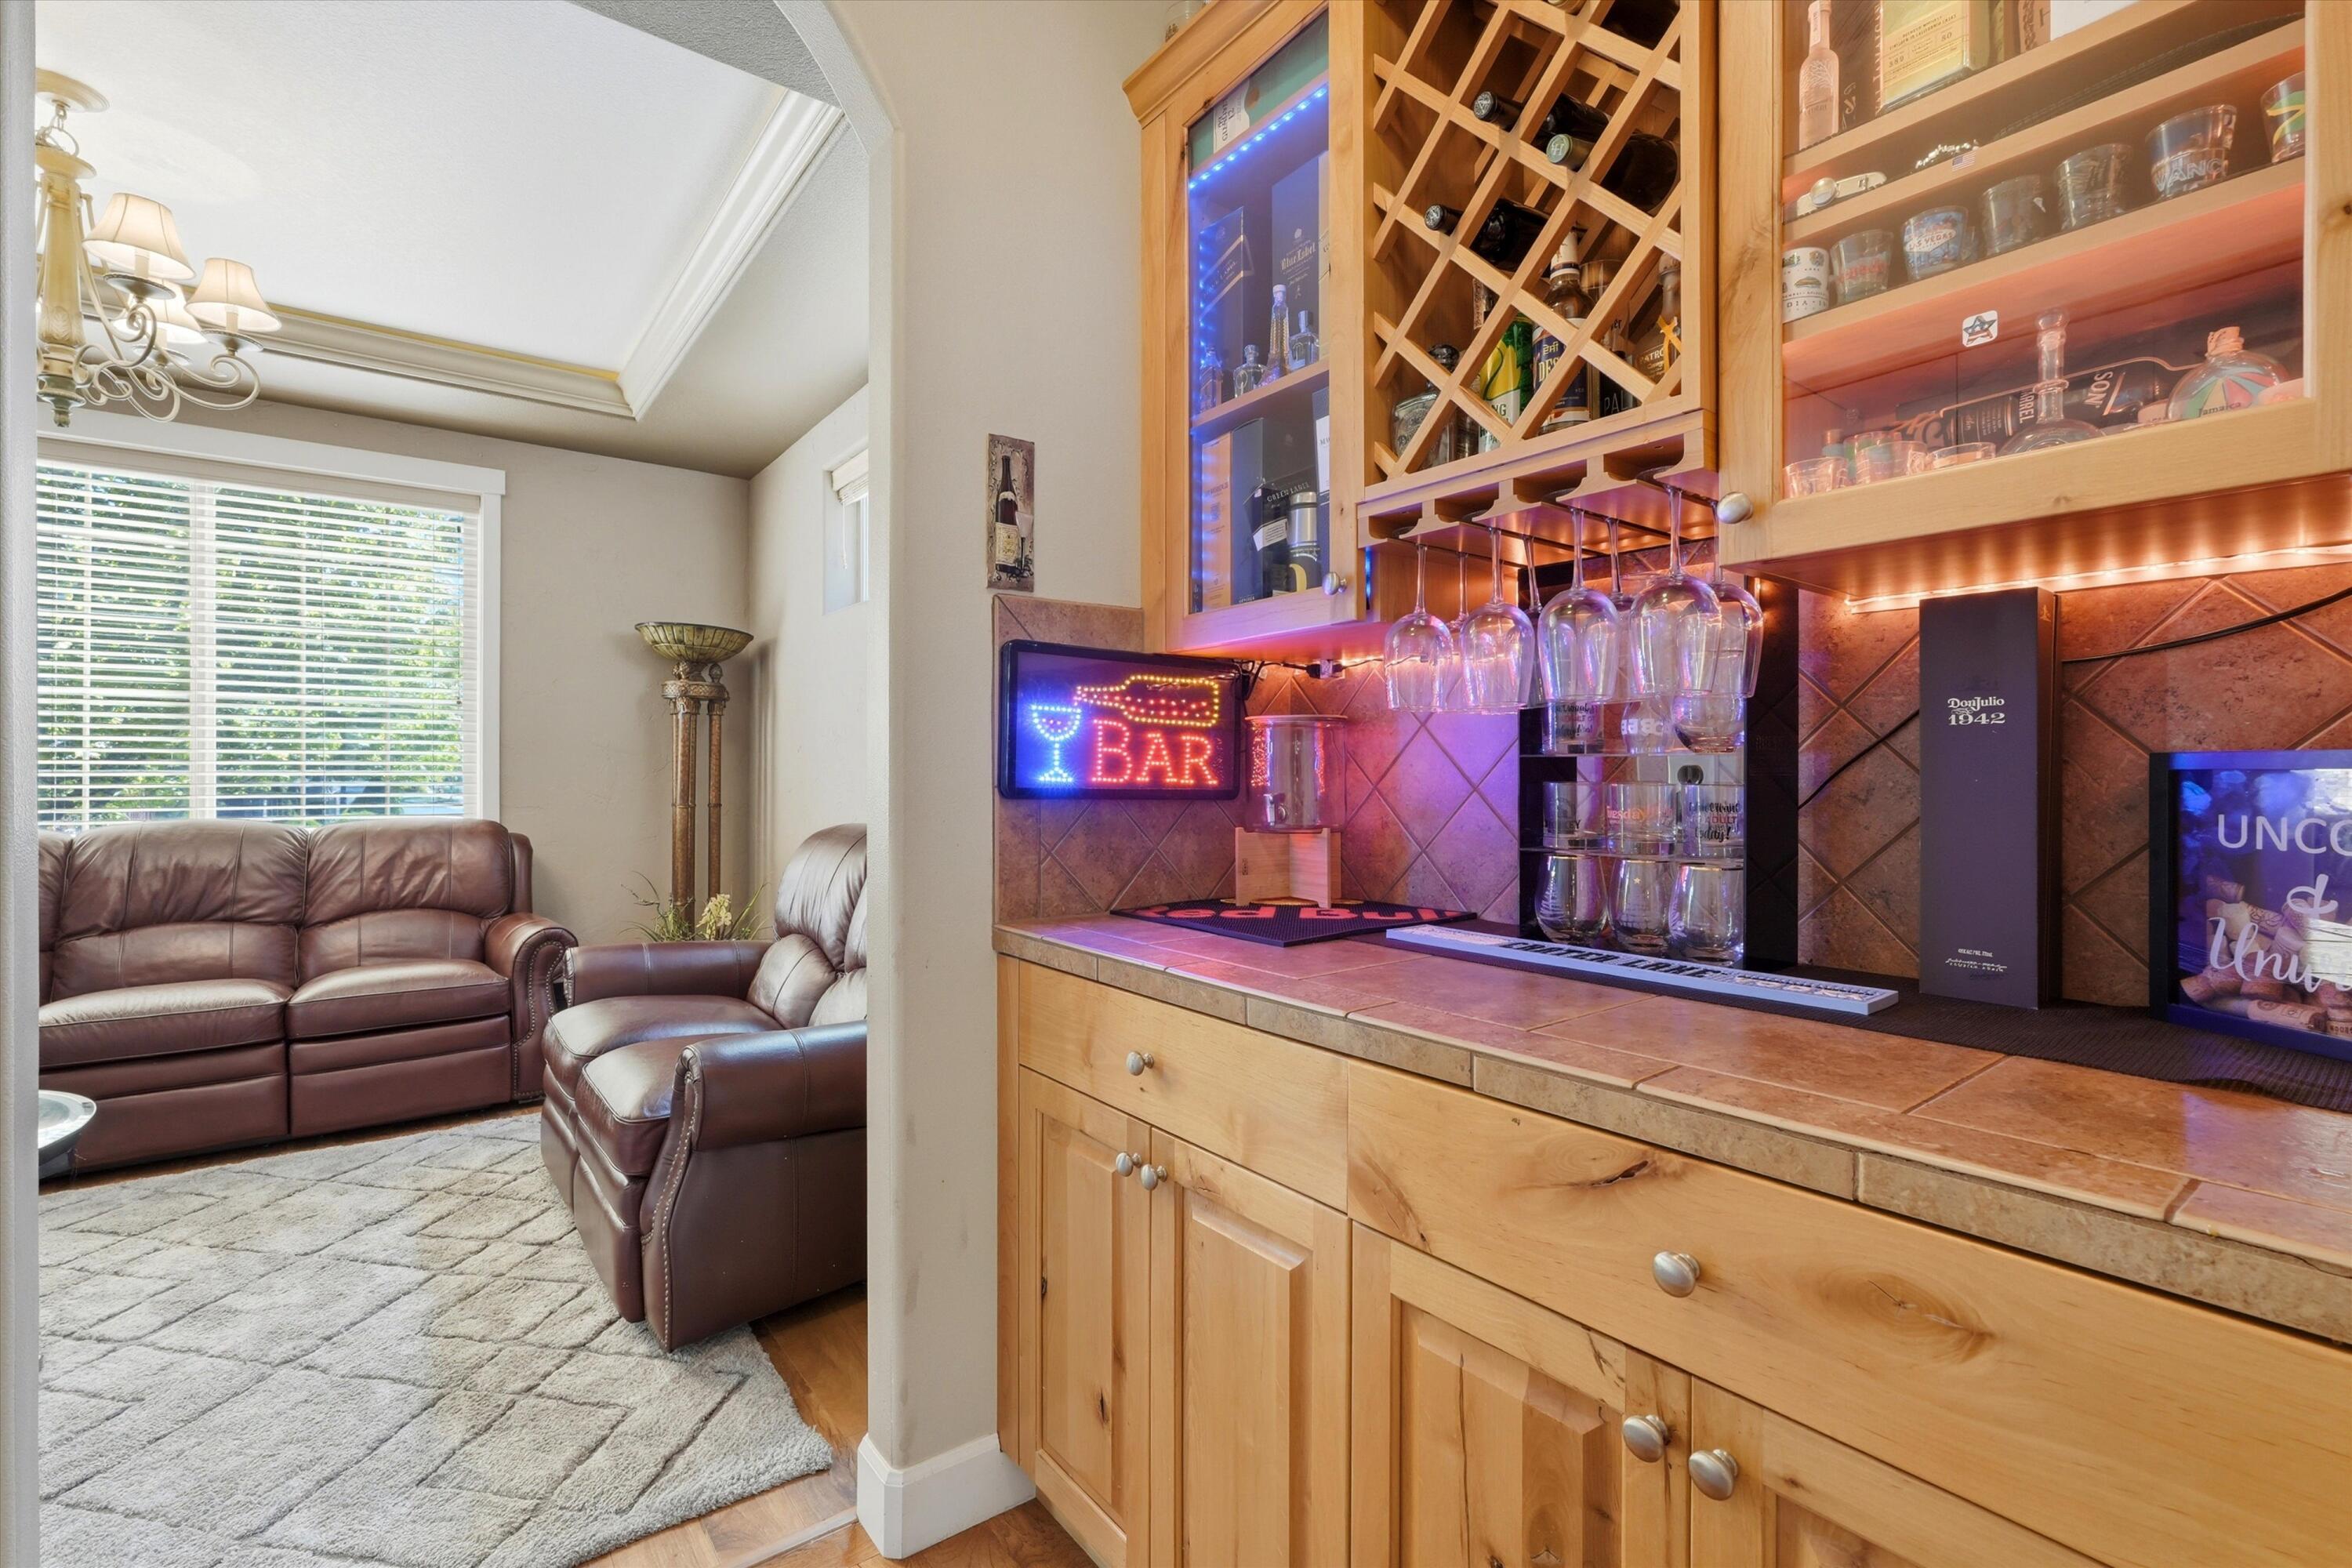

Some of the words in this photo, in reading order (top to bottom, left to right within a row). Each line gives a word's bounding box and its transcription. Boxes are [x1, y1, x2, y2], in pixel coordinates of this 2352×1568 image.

[2198, 401, 2241, 417] Jamaica
[1948, 712, 2005, 725] 1942
[1091, 719, 1218, 784] BAR
[1132, 905, 1276, 917] Red
[1499, 942, 1620, 963] CRATER
[1621, 959, 1722, 978] LAKE
